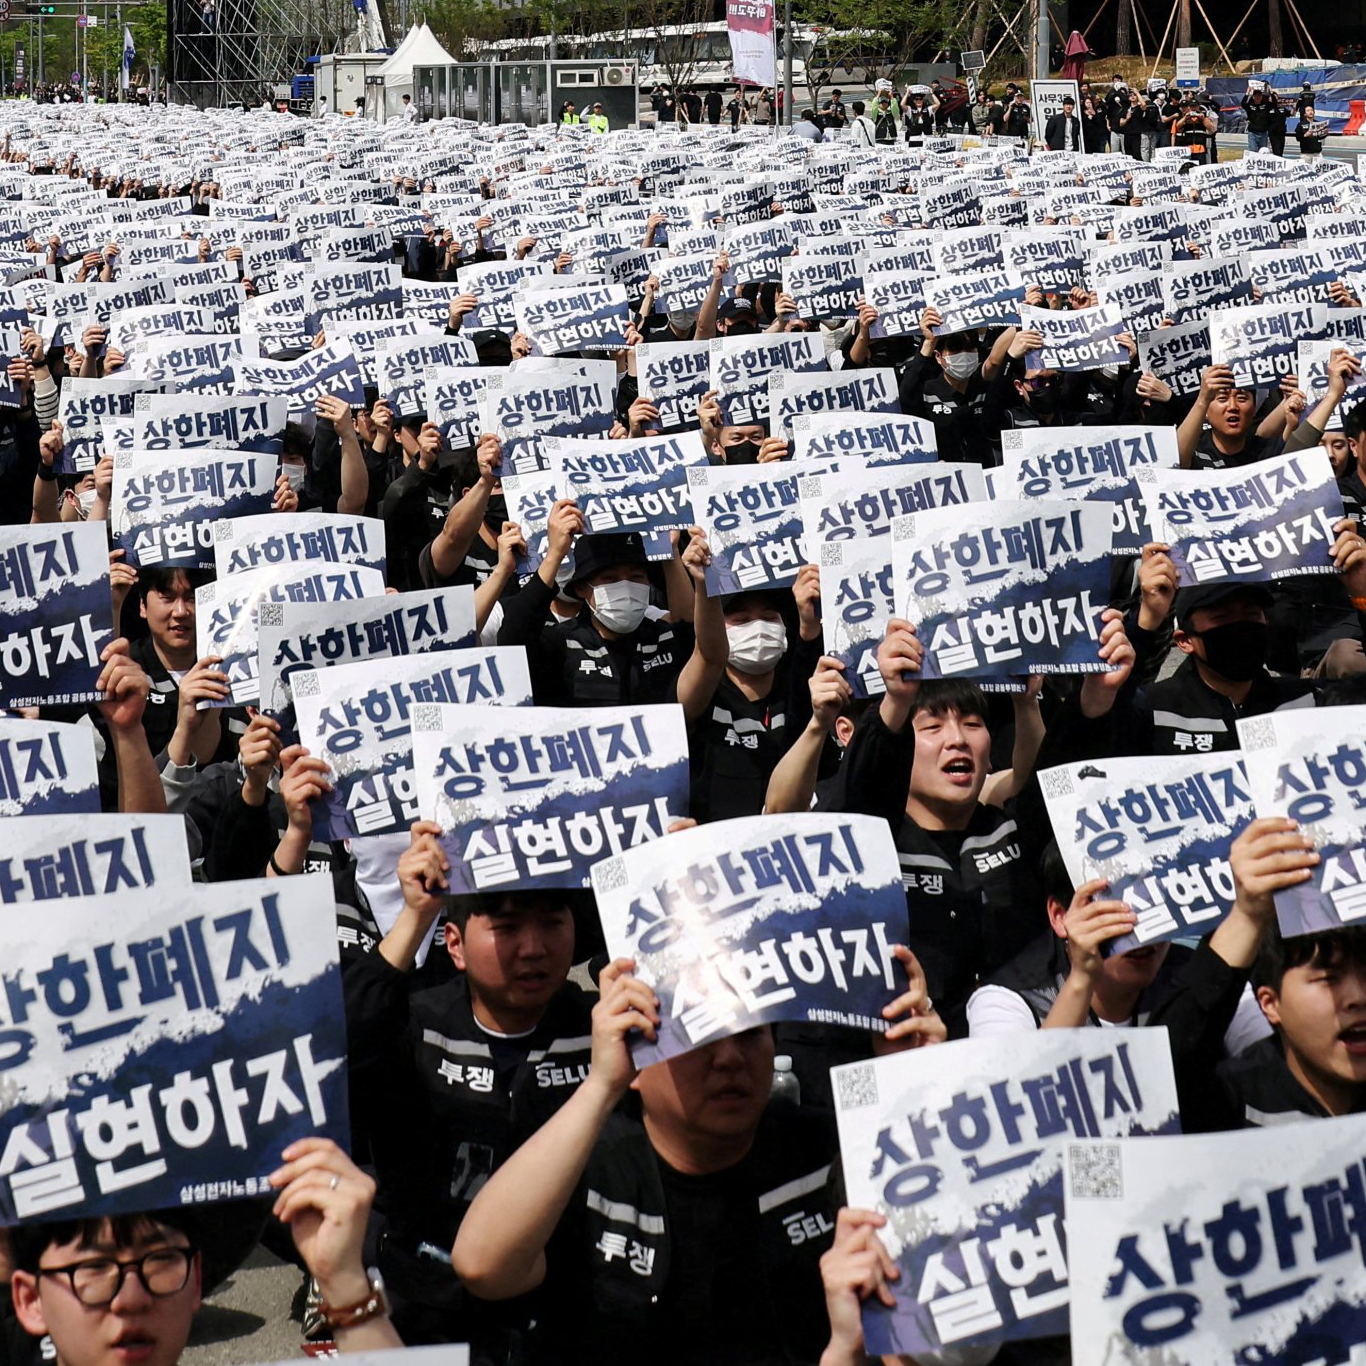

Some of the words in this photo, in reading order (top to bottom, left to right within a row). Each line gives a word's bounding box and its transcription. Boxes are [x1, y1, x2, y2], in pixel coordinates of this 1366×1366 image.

[908, 509, 1084, 598] 상한폐지
[1185, 511, 1339, 582] 실현하자
[928, 590, 1110, 675] 실현하자
[579, 659, 613, 679] 투쟁
[642, 651, 672, 673] SELU
[9, 695, 71, 708] 삼성전자노동조합
[434, 715, 651, 802] 상한폐지
[725, 728, 759, 750] 투쟁
[1173, 732, 1213, 751] 투쟁
[462, 796, 674, 890] 실현하자
[975, 842, 1021, 874] SELU
[625, 824, 865, 955] 상한폐지
[670, 923, 898, 1046] 실현하자
[437, 1062, 495, 1093] 투쟁
[870, 1042, 1144, 1209] 상한폐지
[596, 1231, 655, 1277] 투쟁
